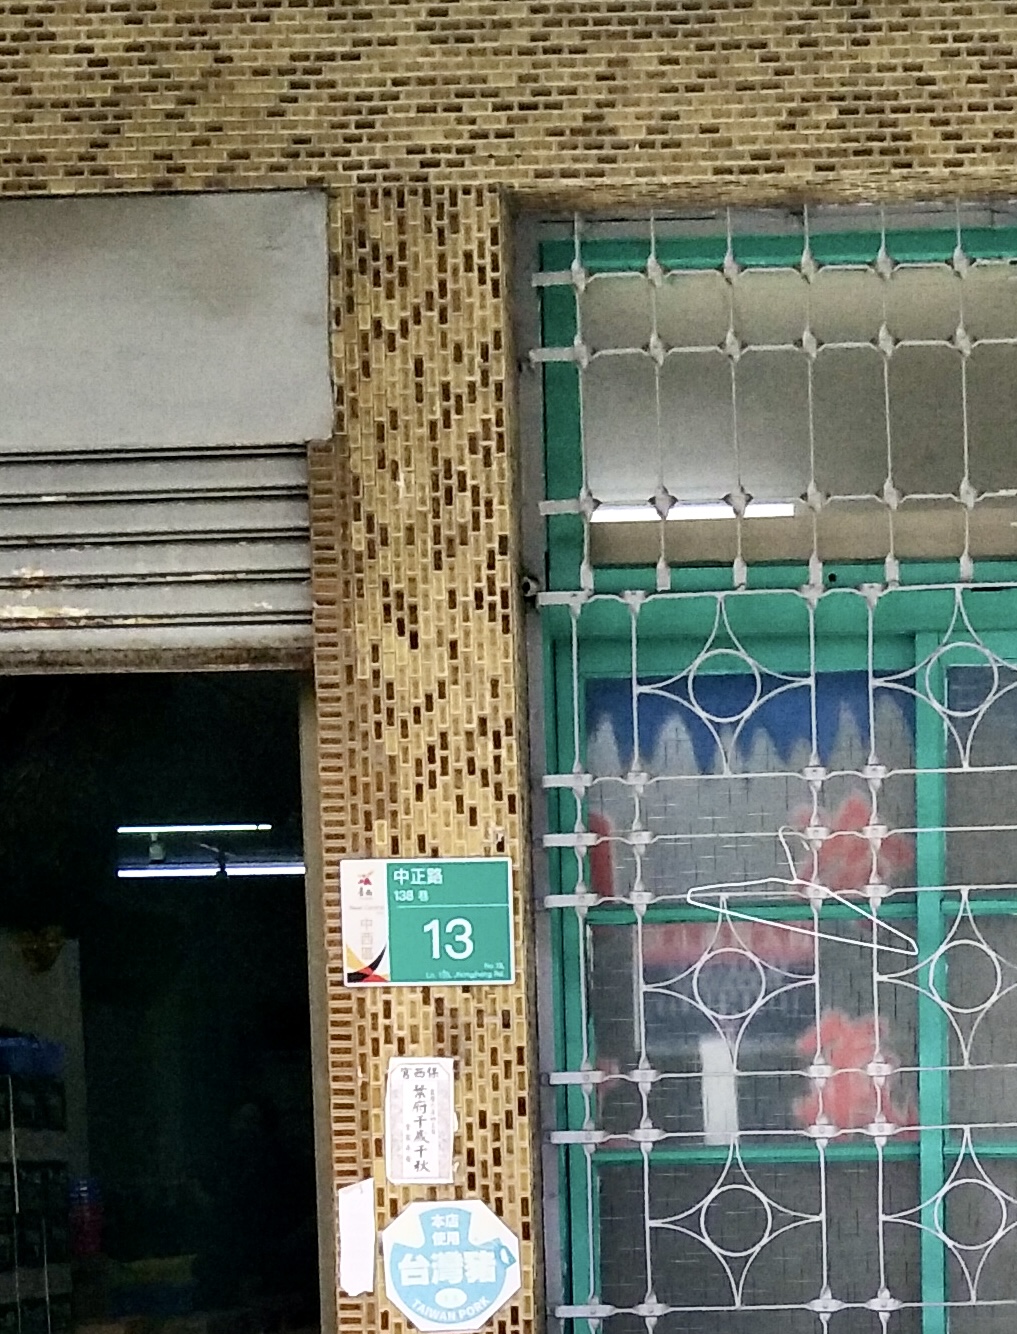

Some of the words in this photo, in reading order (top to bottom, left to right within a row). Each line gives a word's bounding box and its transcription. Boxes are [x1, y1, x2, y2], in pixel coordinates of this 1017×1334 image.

[393, 868, 443, 886] 中正路
[423, 917, 474, 960] 13
[431, 1213, 460, 1228] 本店
[432, 1231, 460, 1246] 使用
[411, 1298, 457, 1321] TAIWAN
[458, 1295, 491, 1319] PORK
